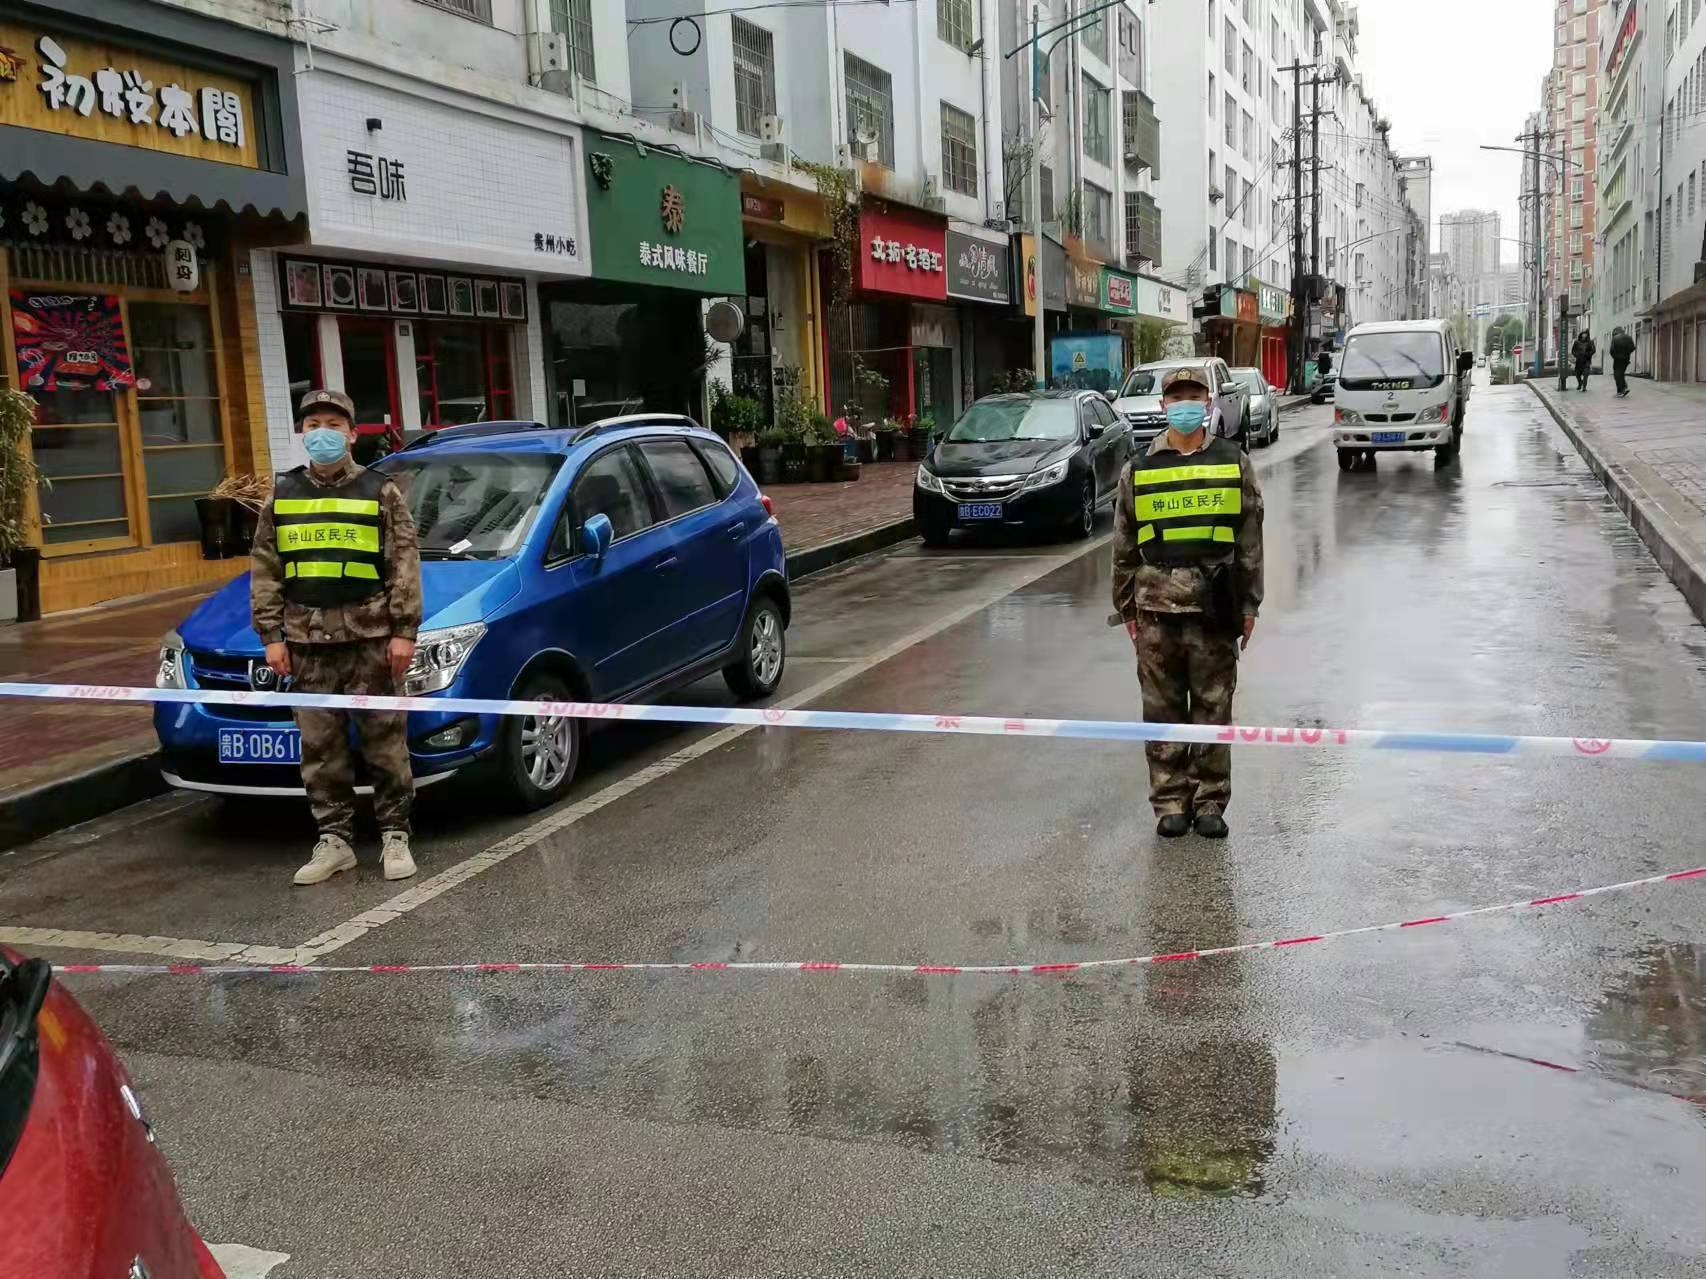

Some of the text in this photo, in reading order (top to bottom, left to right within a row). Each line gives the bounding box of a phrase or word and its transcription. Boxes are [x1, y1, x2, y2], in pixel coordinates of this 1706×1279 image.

[347, 149, 406, 201] 吾味
[663, 184, 684, 233] 泰
[533, 232, 577, 257] 贵州小吃
[639, 241, 708, 275] 泰式风味餐厅
[1387, 392, 1394, 400] 2
[1152, 493, 1225, 512] 钟山区民兵
[288, 528, 358, 544] 钟山区民兵
[221, 733, 302, 759] 贵B·0B61
